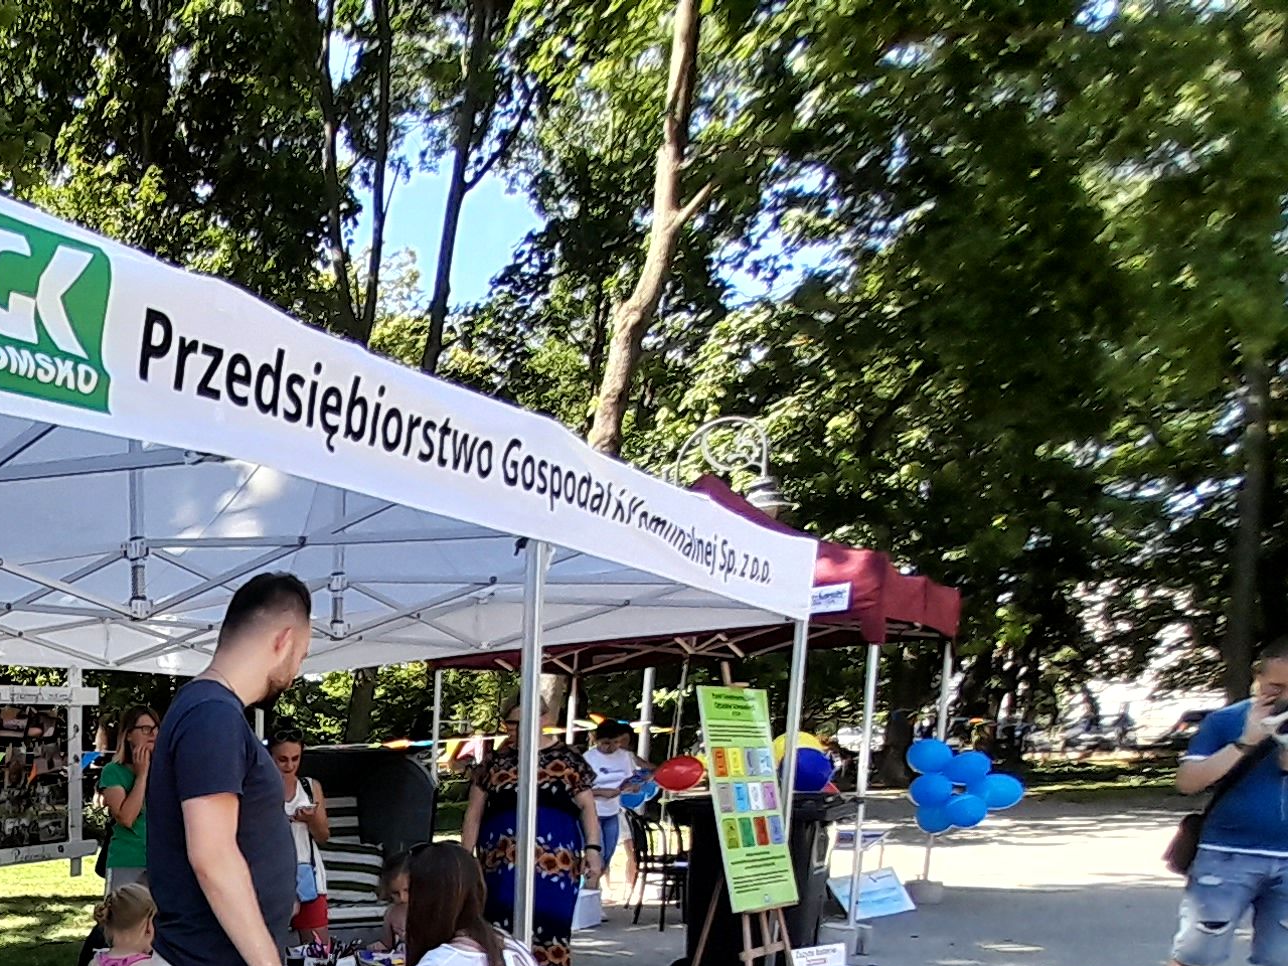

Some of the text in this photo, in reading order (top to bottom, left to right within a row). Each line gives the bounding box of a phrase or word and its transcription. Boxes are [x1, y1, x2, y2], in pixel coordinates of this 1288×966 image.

[139, 306, 493, 479] Przedsiębiorstwo
[720, 538, 737, 583] Sp.
[739, 553, 750, 578] z
